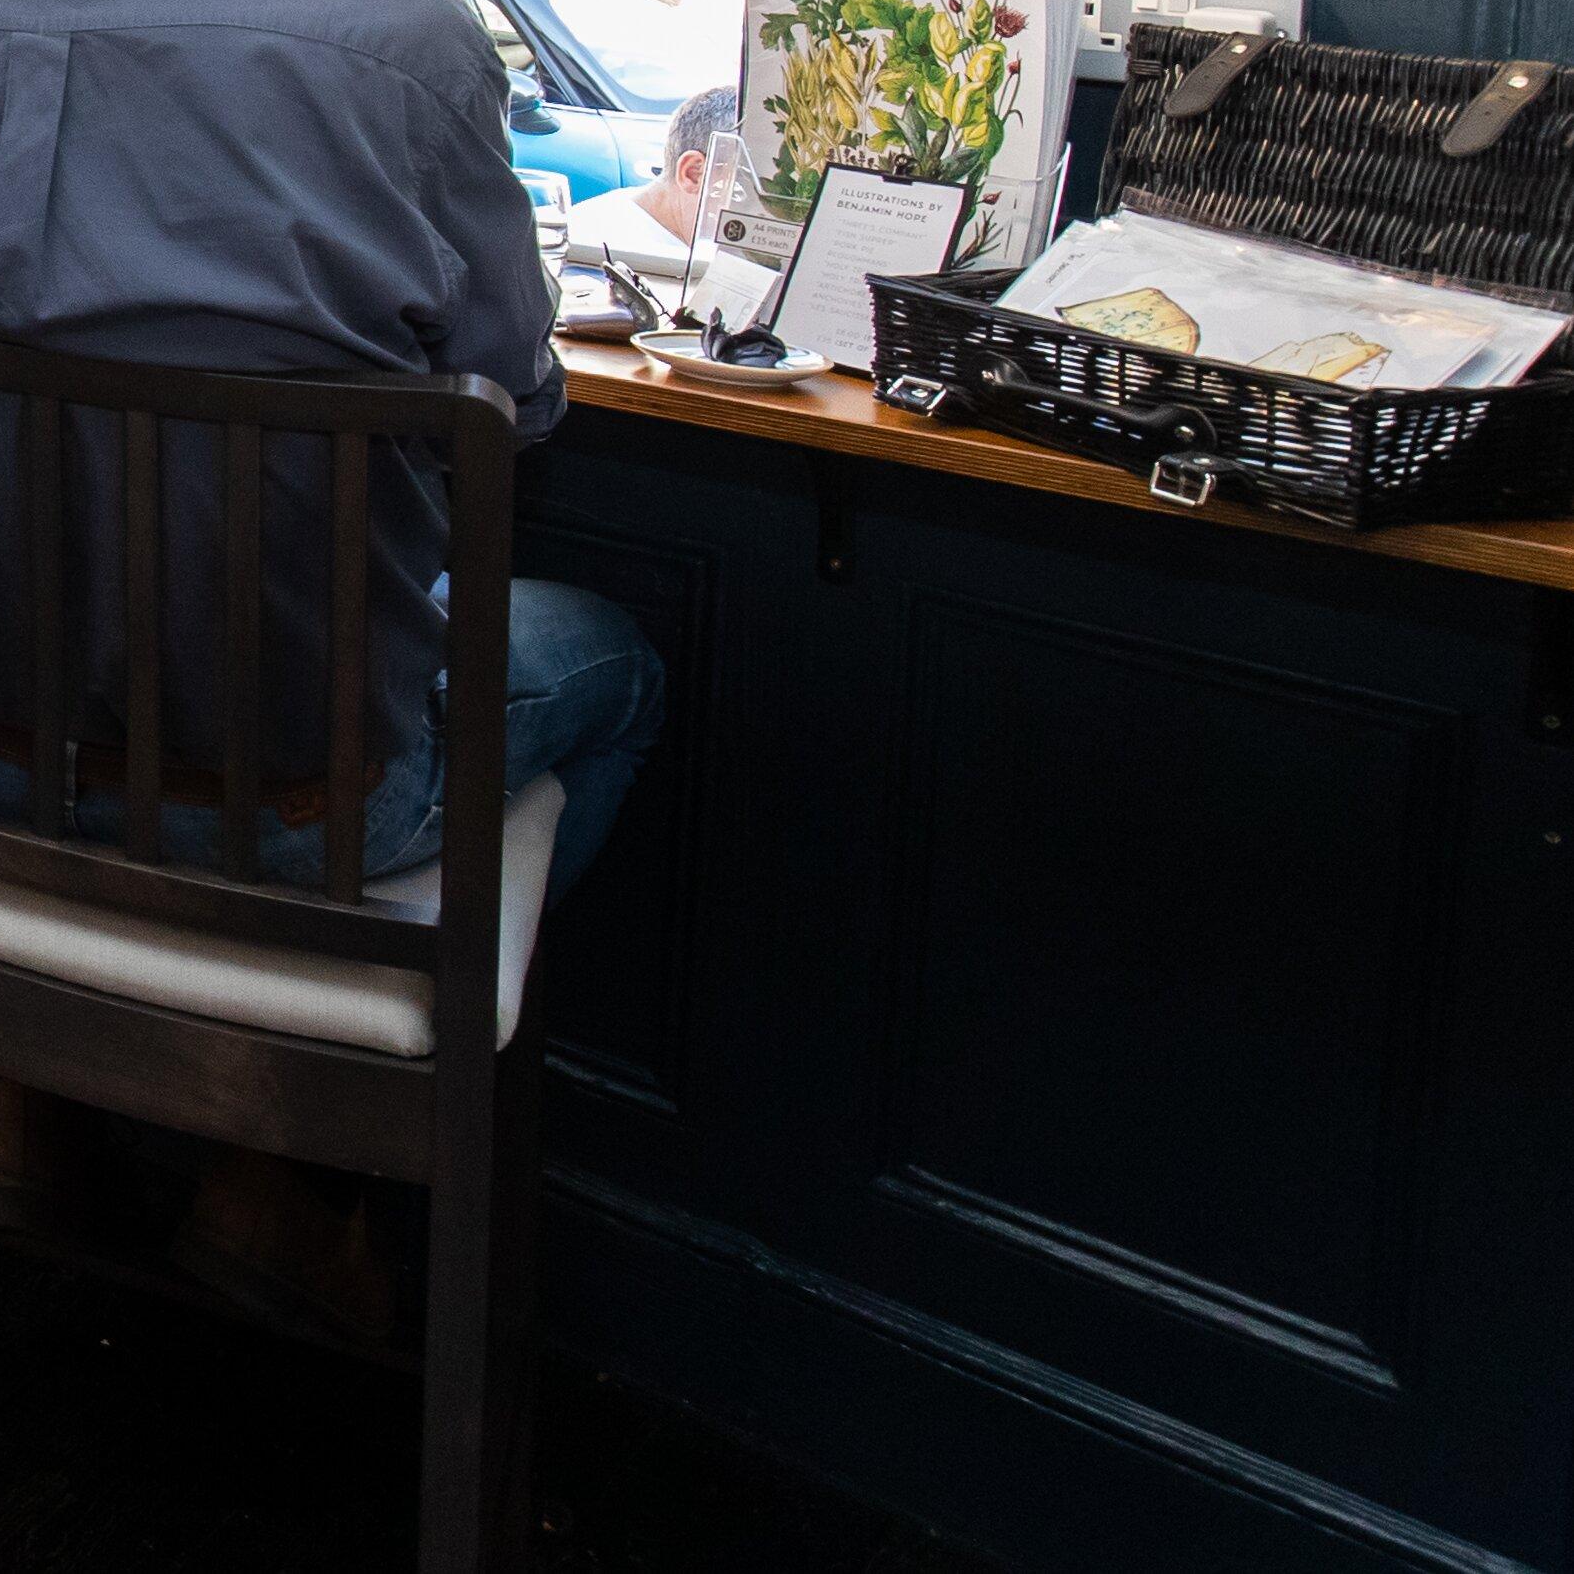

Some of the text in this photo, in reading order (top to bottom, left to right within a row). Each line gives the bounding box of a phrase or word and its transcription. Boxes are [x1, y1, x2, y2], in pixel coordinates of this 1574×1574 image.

[841, 188, 944, 213] ILLUSTRATIONS BY
[837, 200, 929, 223] BENJAMIN HOPE
[754, 224, 798, 238] A4 PRINTS
[751, 236, 788, 249] £15 each
